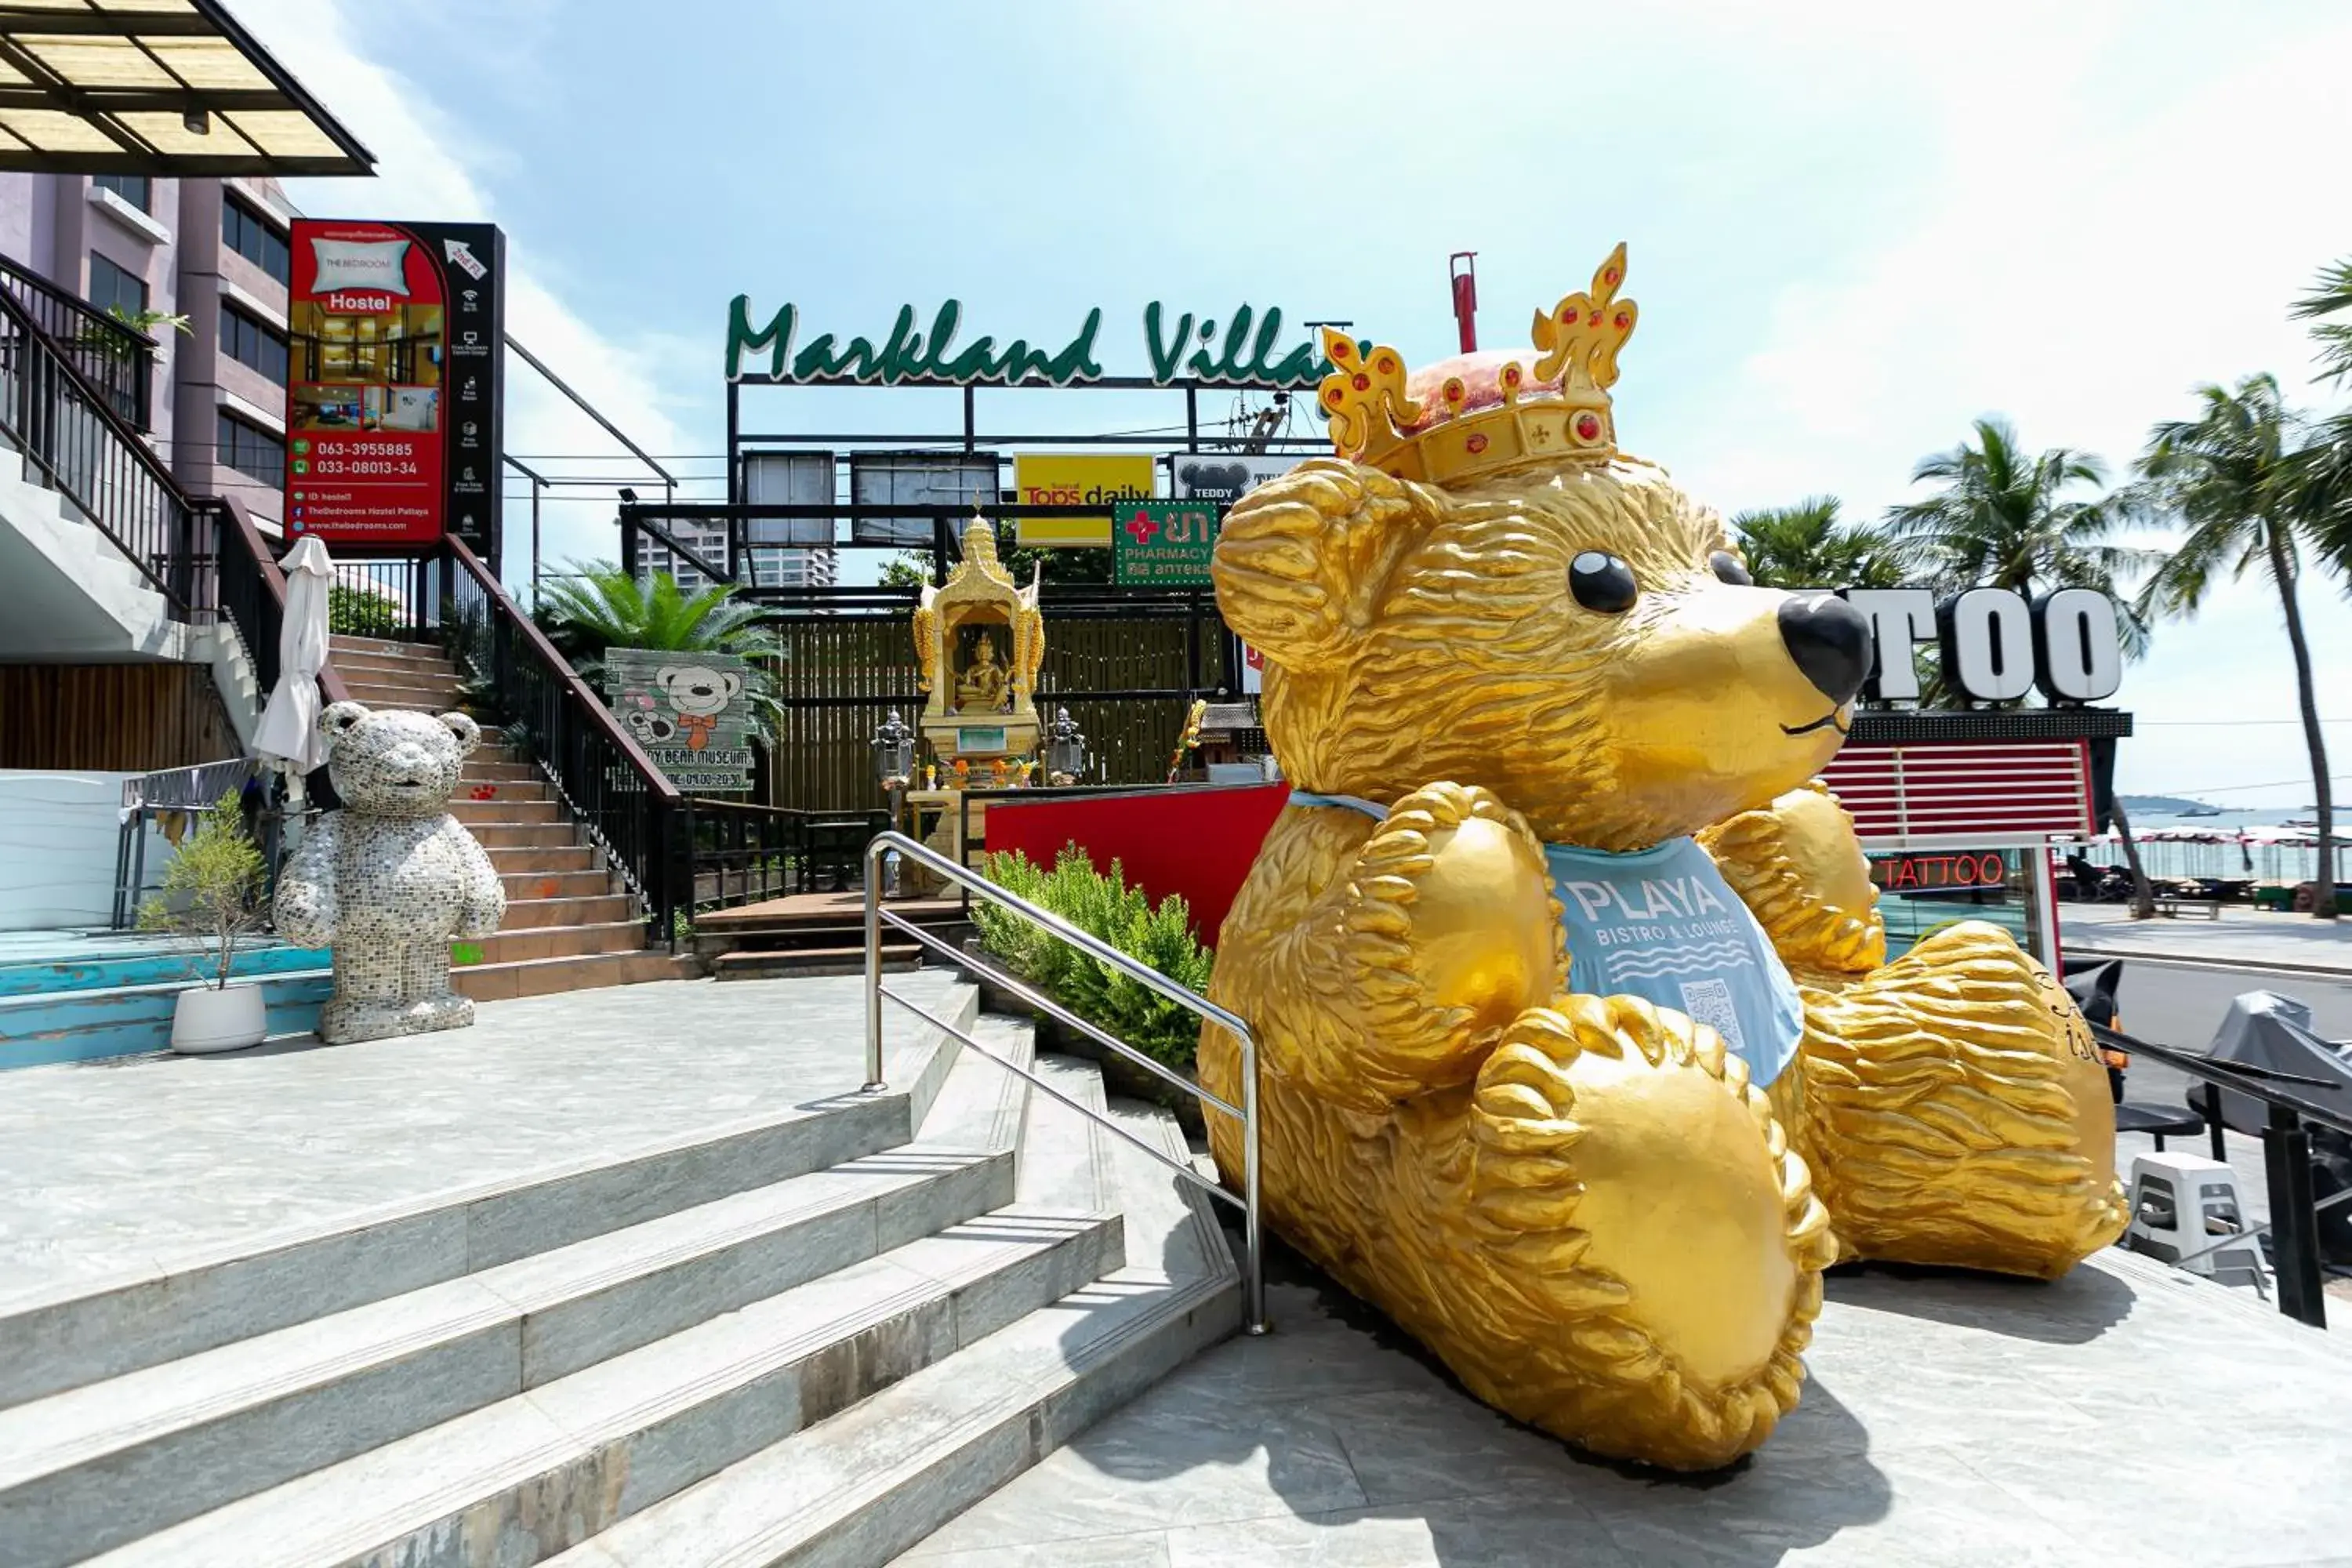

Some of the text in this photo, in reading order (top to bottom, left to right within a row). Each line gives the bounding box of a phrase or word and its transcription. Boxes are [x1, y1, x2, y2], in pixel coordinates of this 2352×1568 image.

[330, 293, 390, 310] Hostel
[726, 293, 1105, 386] Markland
[318, 442, 412, 456] 063-3955885
[318, 460, 417, 474] 033-08013-34
[1023, 487, 1080, 504] Tops
[1194, 488, 1232, 497] TEDDY
[397, 508, 429, 517] Pattaya
[1166, 512, 1208, 543] ยา
[1126, 548, 1208, 560] PHARMACY
[666, 750, 695, 764] BEAR
[697, 750, 747, 764] MUSEUM
[1879, 854, 2003, 888] TATTOO
[1563, 875, 1726, 922] PLAYA
[1595, 926, 1666, 946] BISTRO
[1685, 919, 1740, 938] LOUNGE
